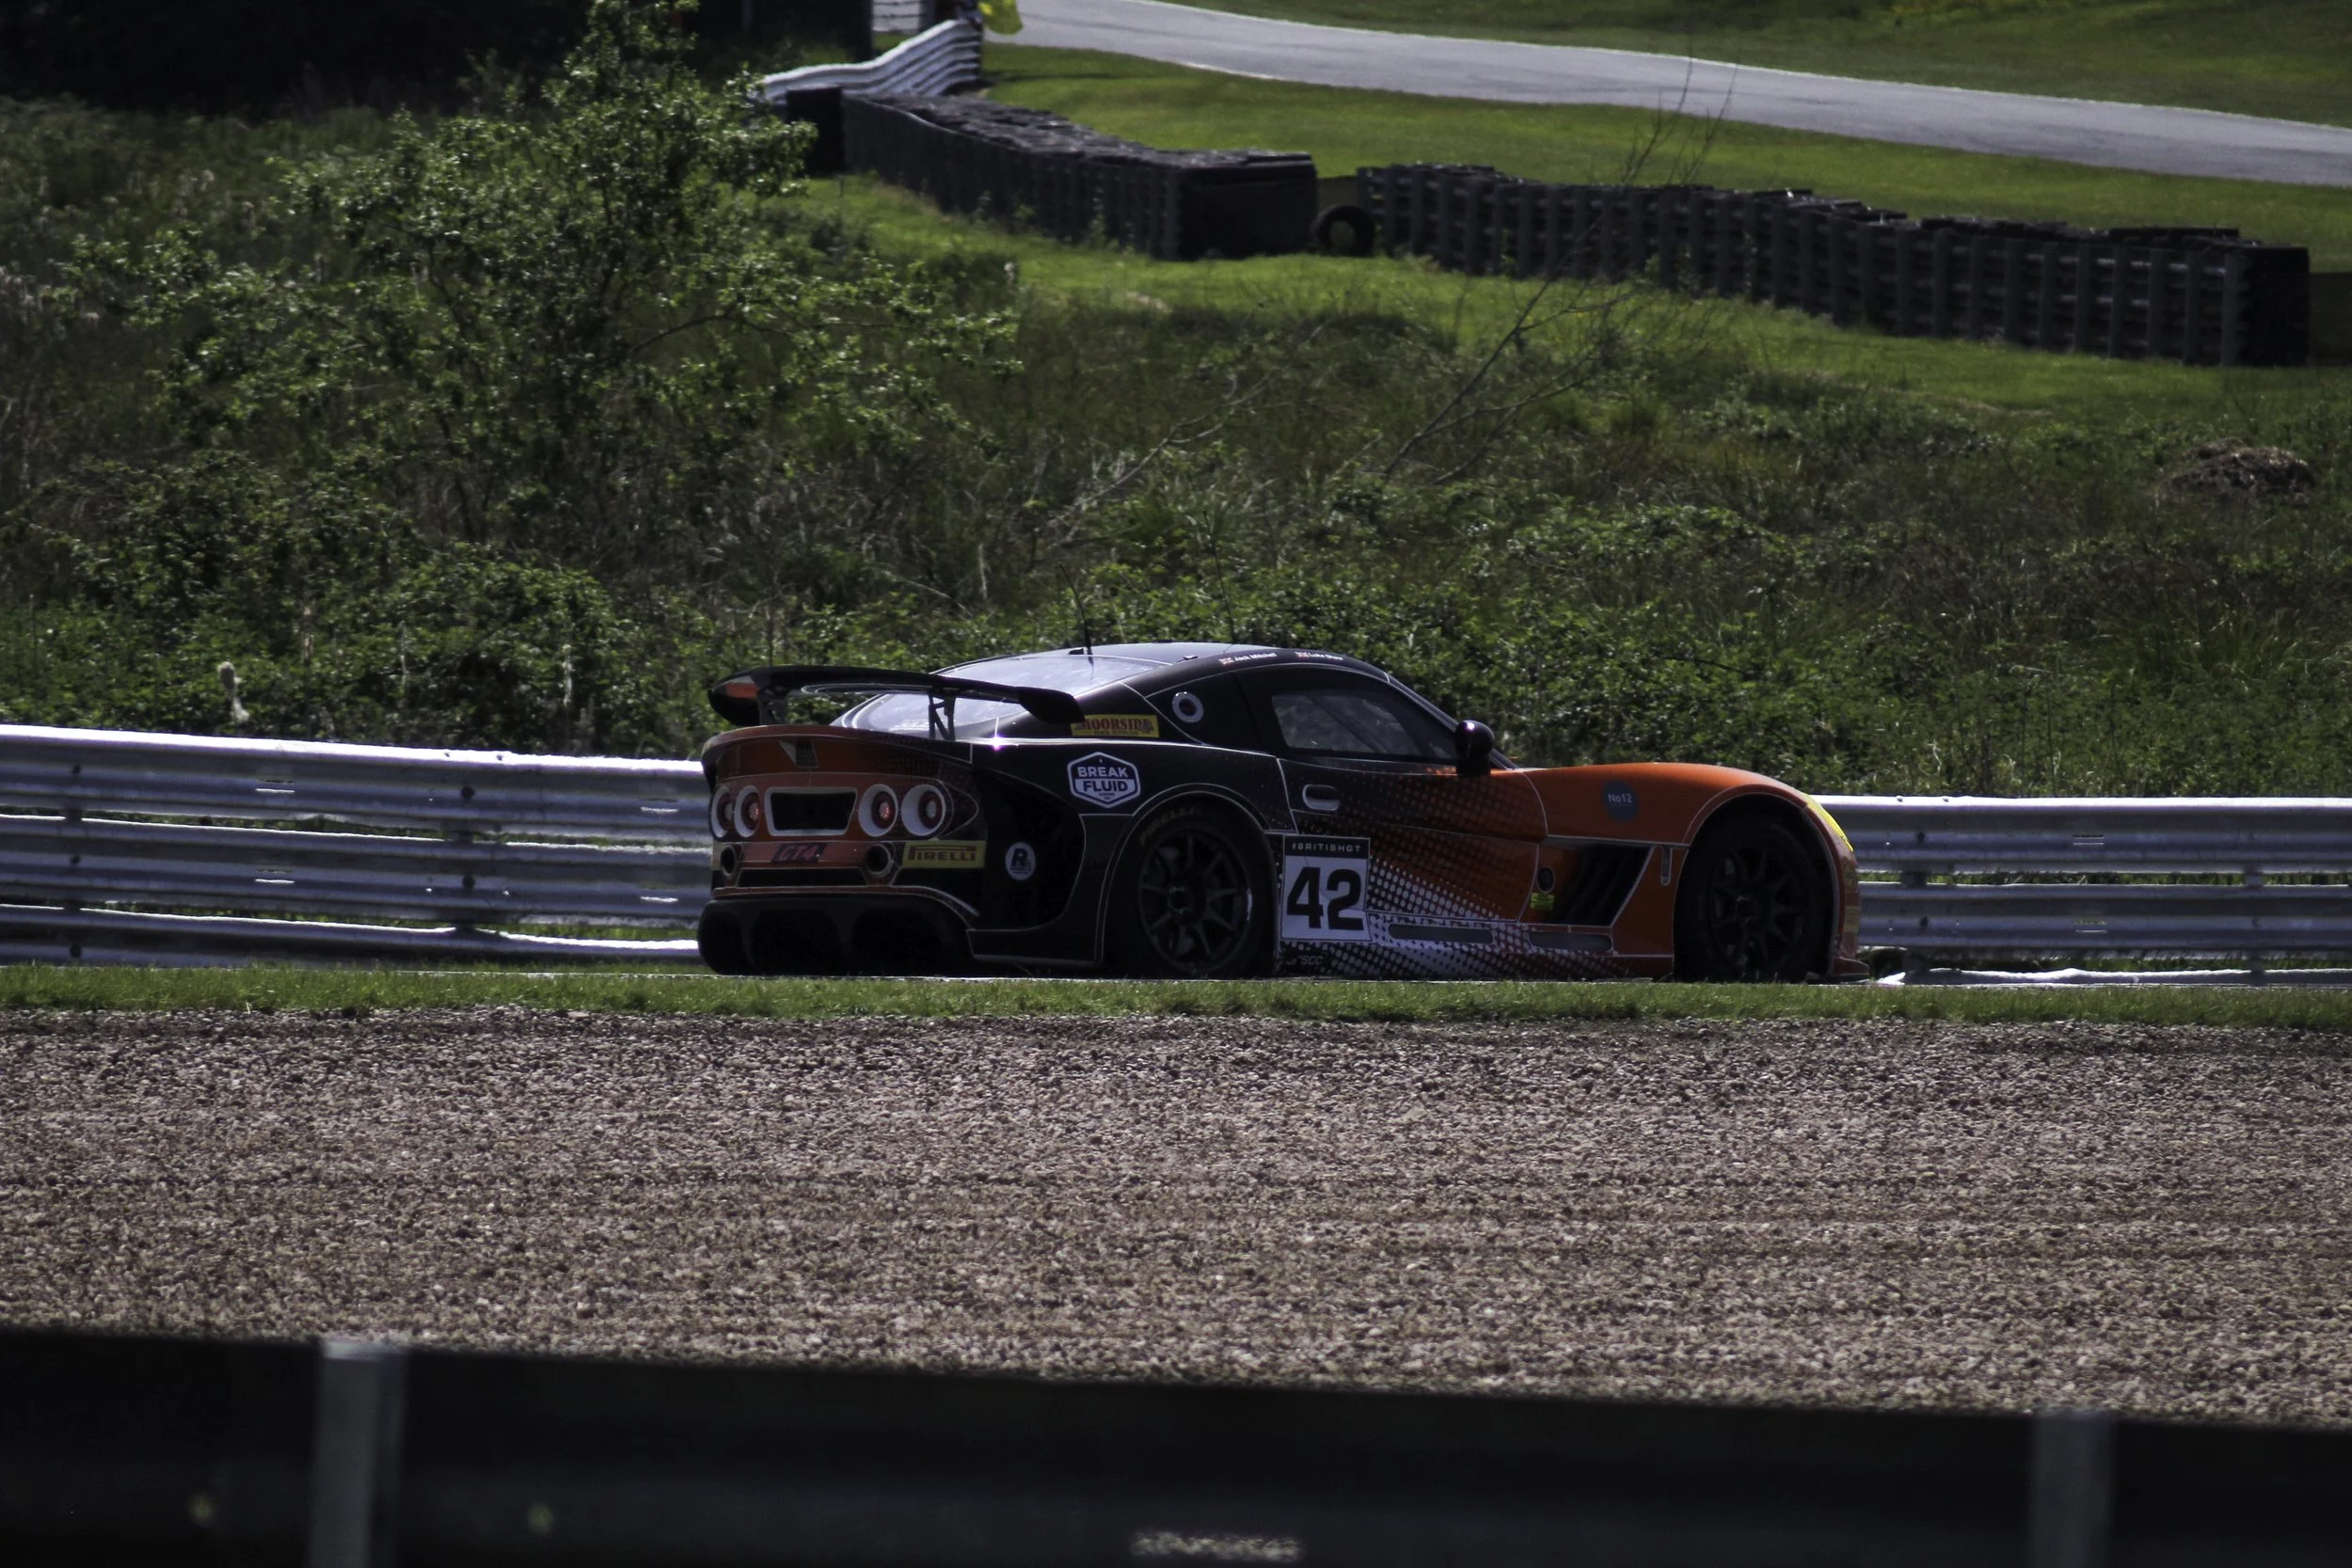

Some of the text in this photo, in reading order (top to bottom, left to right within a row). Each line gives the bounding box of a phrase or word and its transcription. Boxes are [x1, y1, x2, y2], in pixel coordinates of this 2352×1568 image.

[1077, 766, 1129, 778] BREAK
[1083, 780, 1128, 792] FLUID
[908, 845, 977, 862] PIRELLI
[1287, 866, 1364, 930] 42
